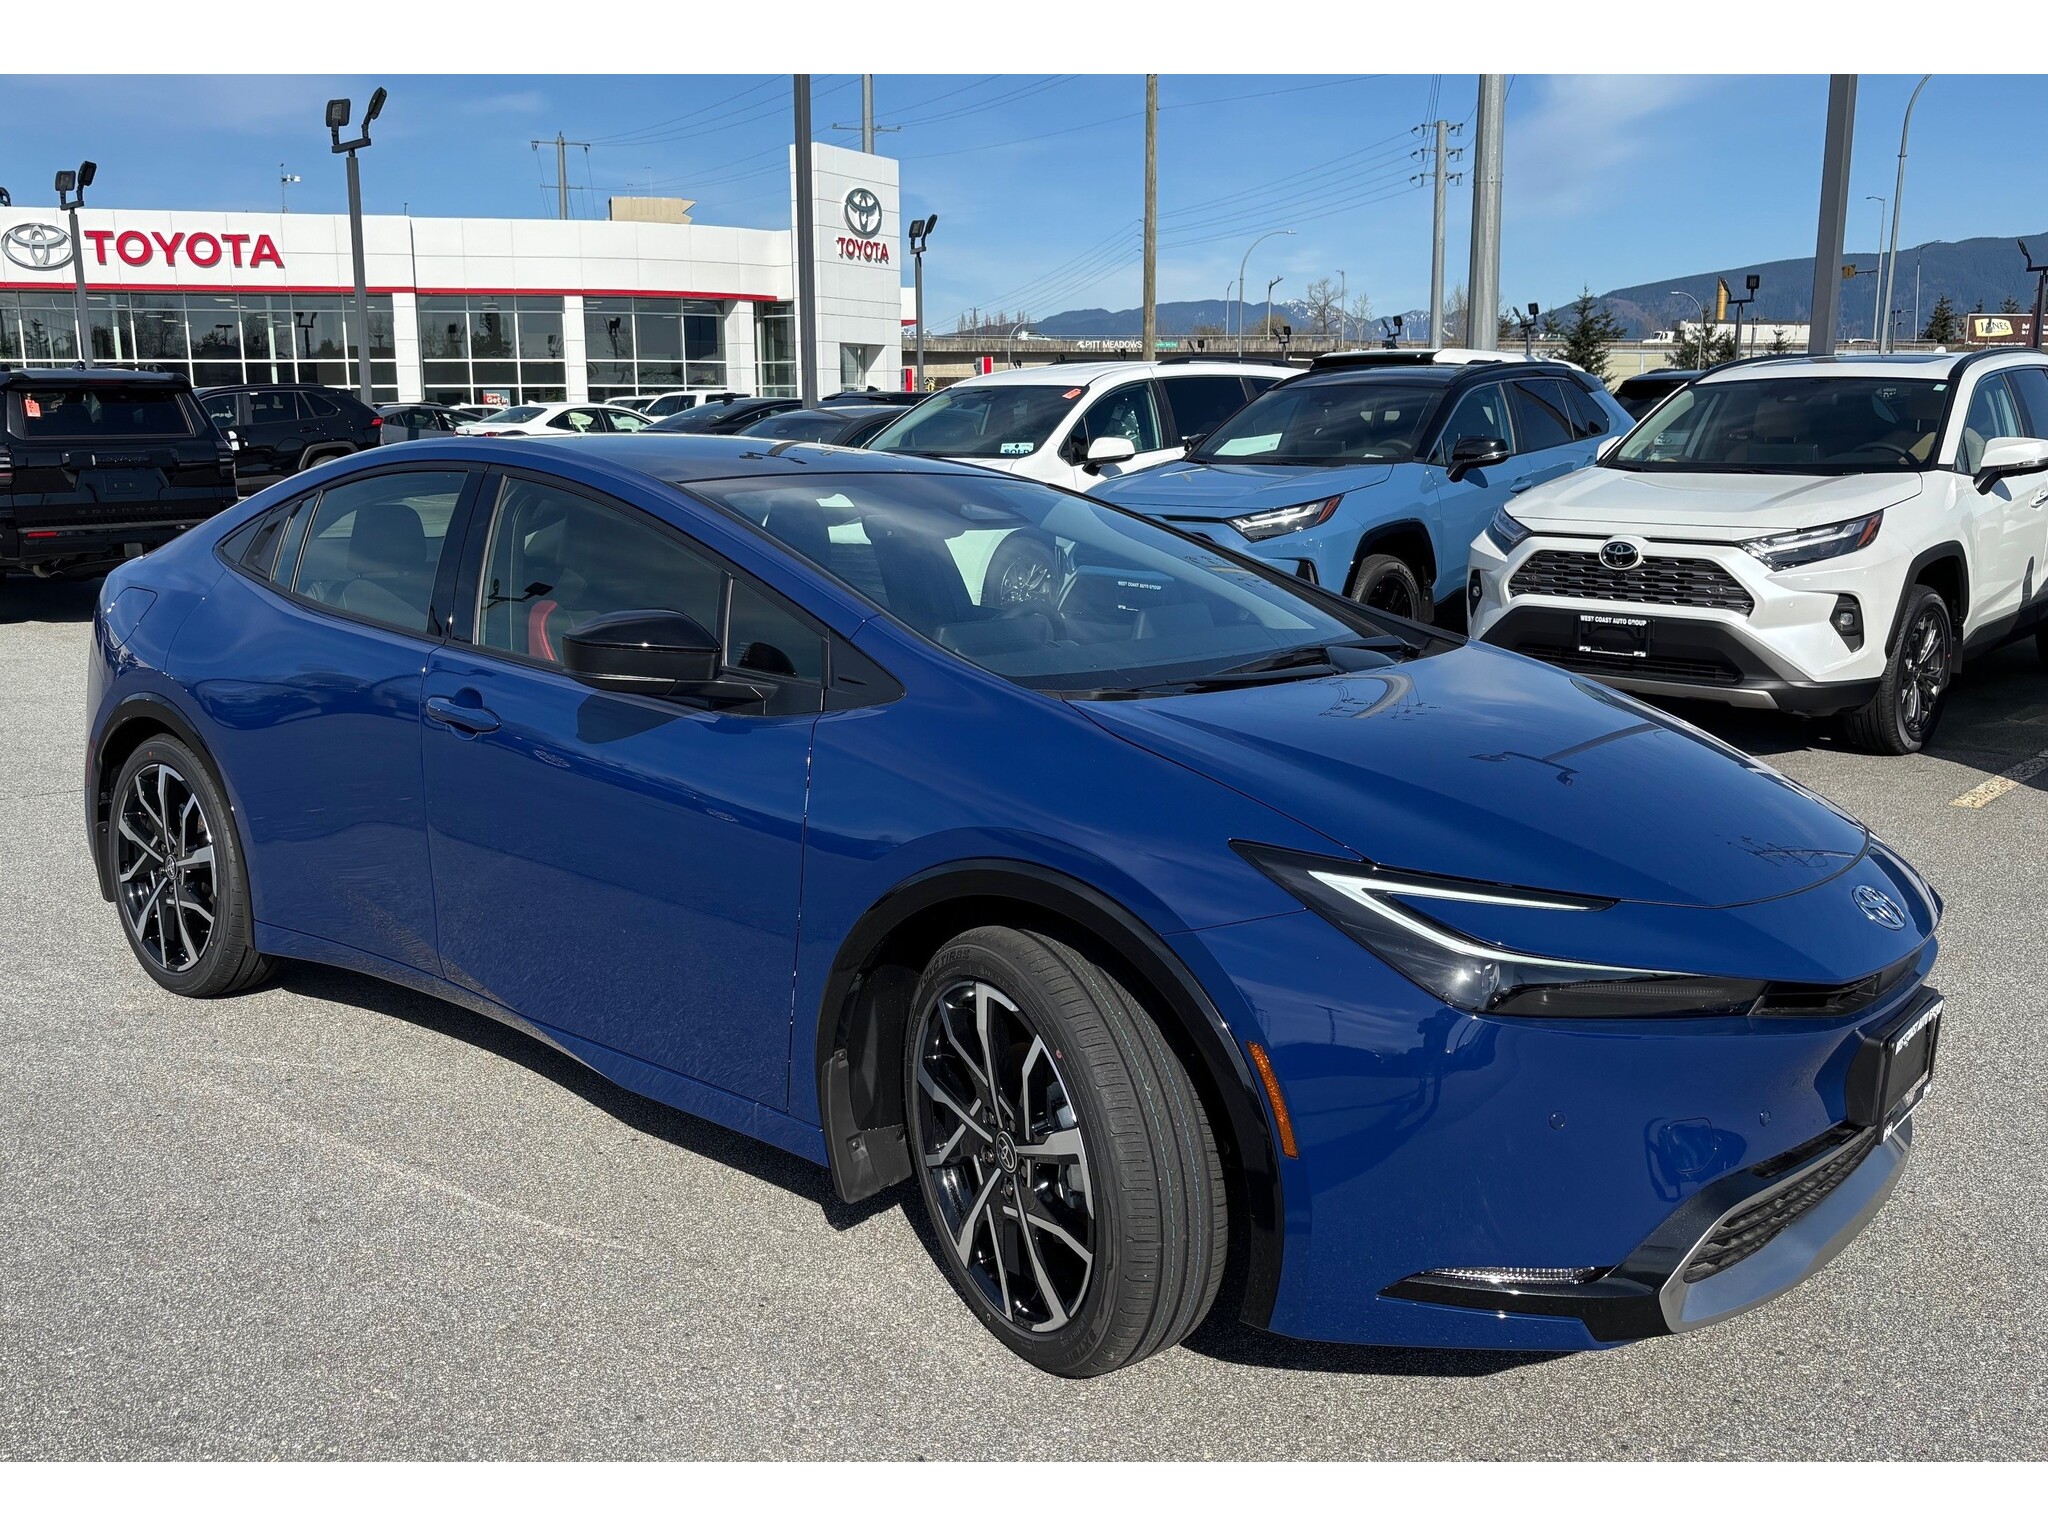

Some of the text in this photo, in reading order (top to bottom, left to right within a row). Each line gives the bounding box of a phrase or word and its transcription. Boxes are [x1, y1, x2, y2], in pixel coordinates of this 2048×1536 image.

[84, 230, 285, 269] TOYOTA
[837, 237, 889, 263] TOYOTA
[1981, 322, 2009, 332] JNES
[1085, 340, 1143, 349] PITT MEADOWS
